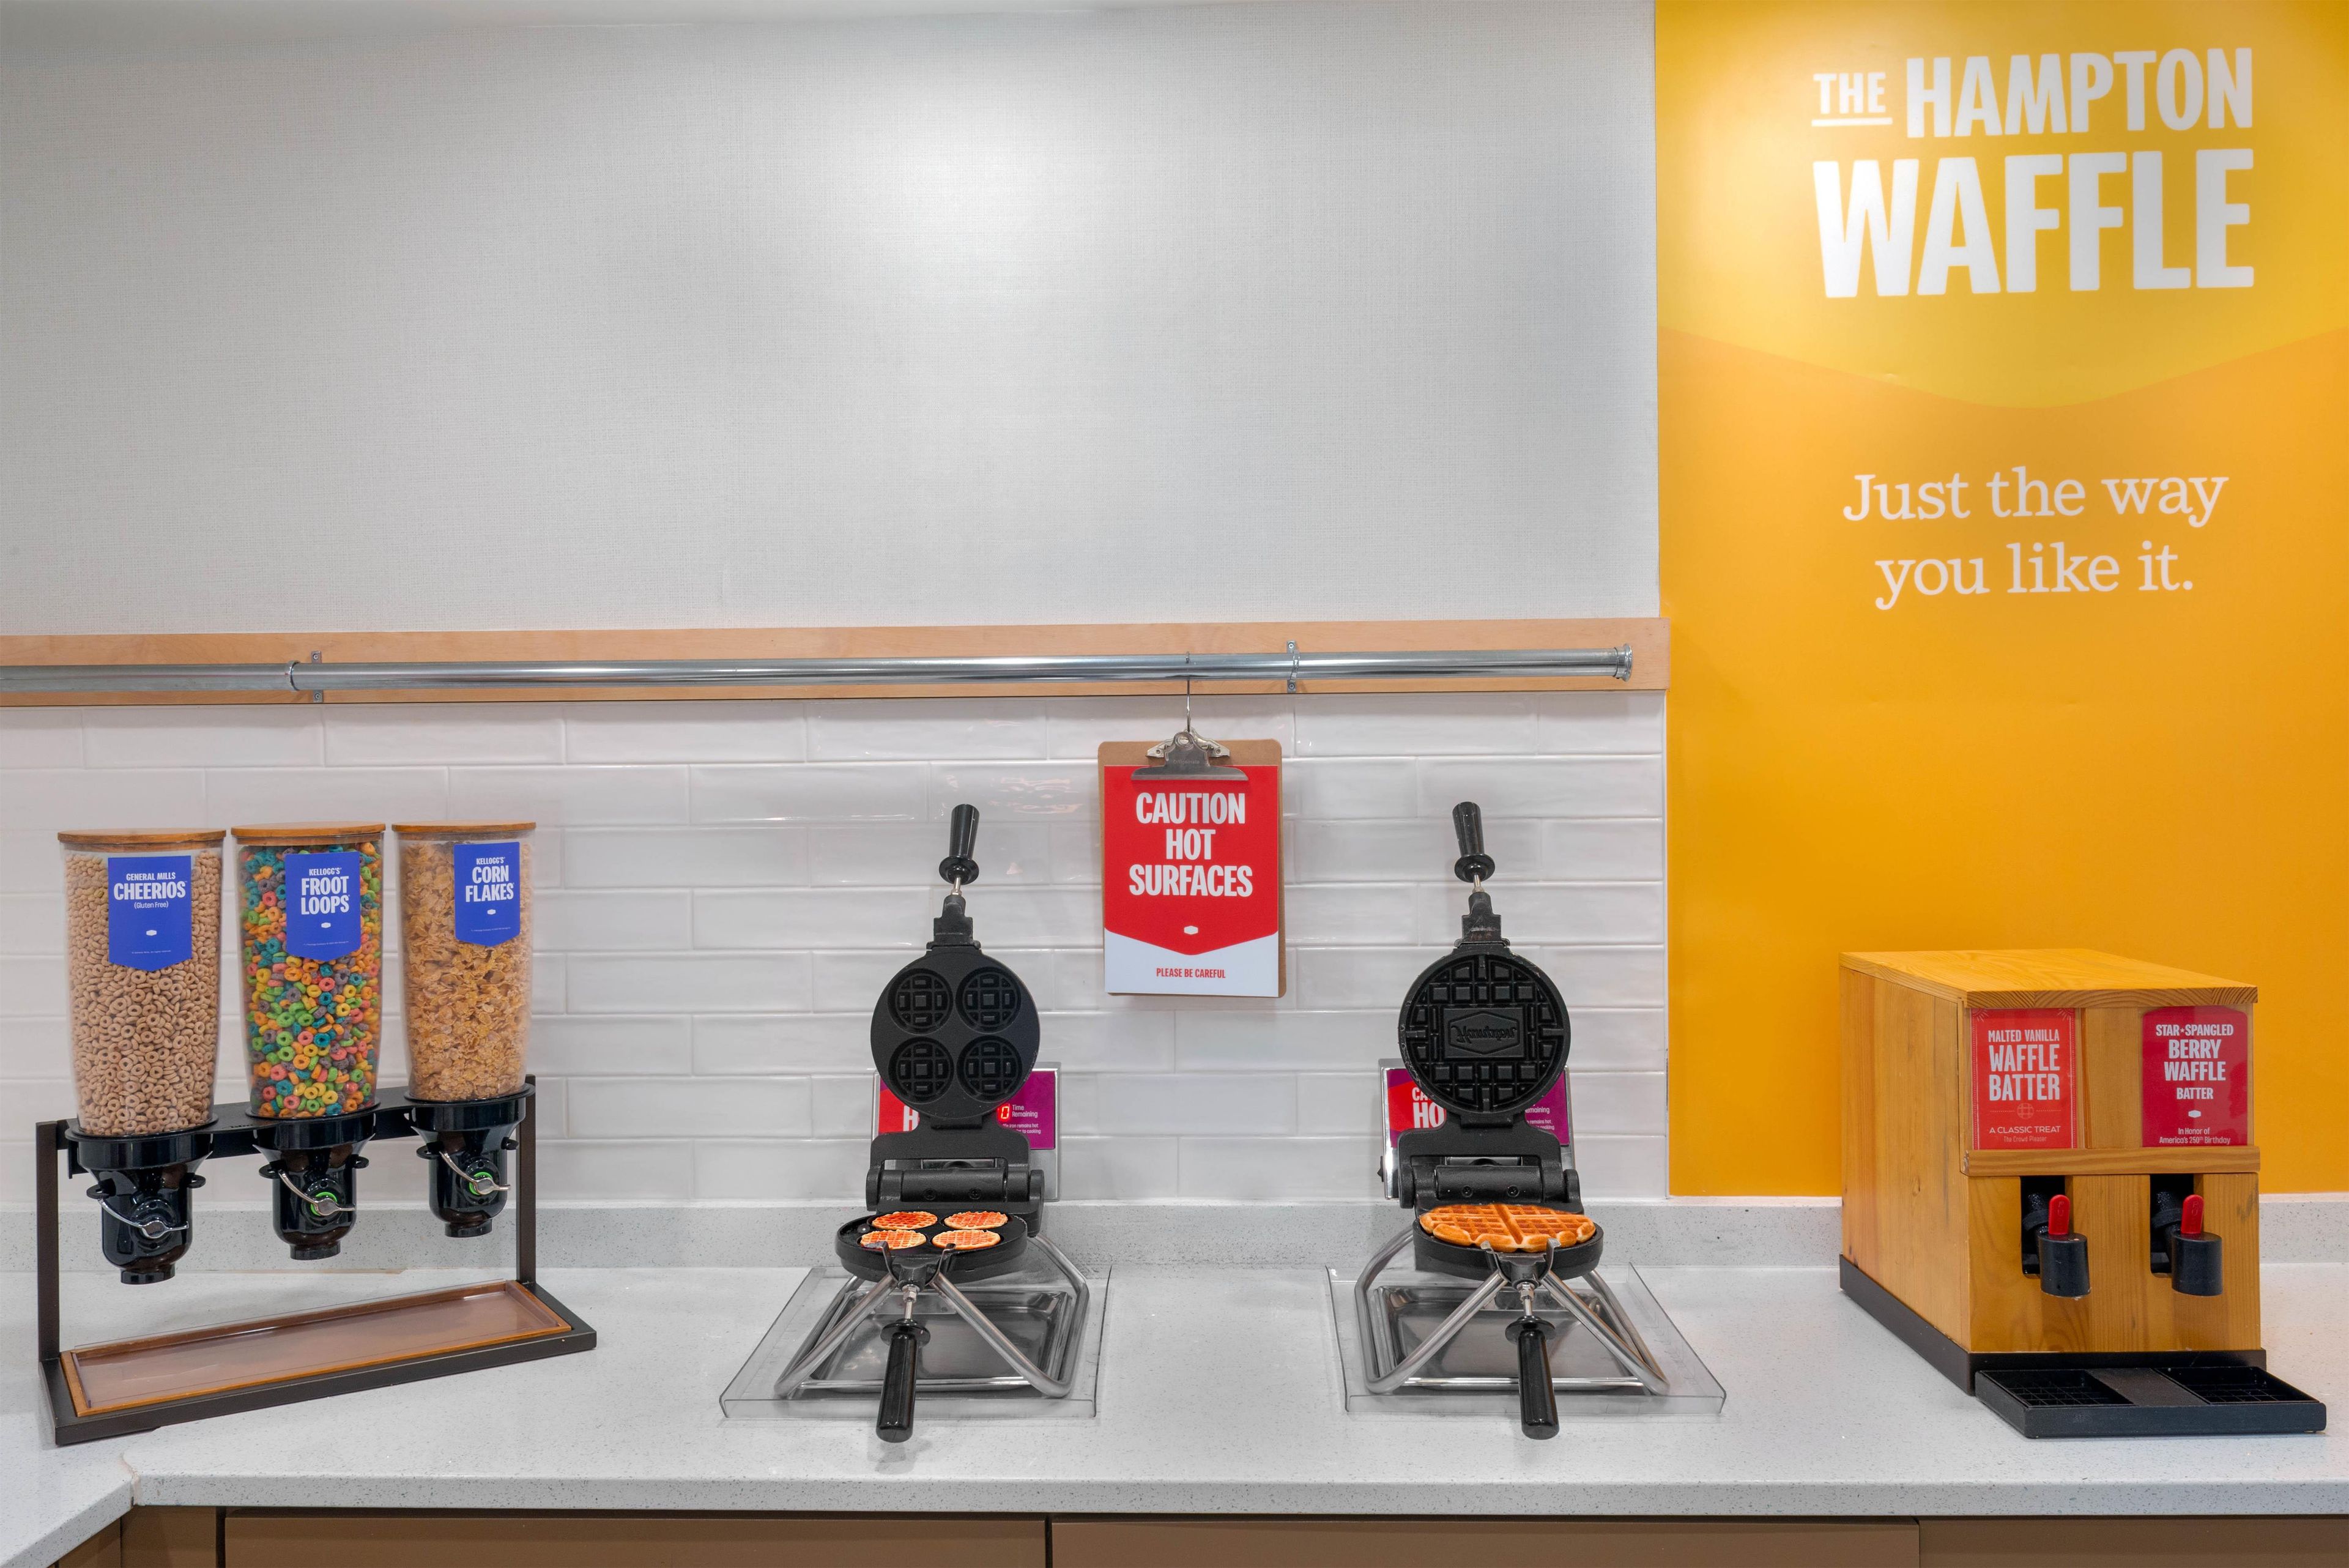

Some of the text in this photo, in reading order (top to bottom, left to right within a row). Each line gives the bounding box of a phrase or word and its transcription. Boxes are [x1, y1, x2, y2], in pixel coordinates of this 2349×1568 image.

[1814, 48, 2252, 139] THE HAMPTON
[1813, 149, 2254, 299] WAFFLE
[1843, 466, 2229, 527] Just the way
[1876, 541, 2192, 610] you like it.
[1136, 793, 1245, 824] CAUTION
[1166, 829, 1216, 860] HOT
[157, 872, 176, 880] MILLS
[309, 868, 341, 876] KELLOGG'S
[472, 865, 509, 883] CORN
[1129, 864, 1253, 897] SURFACES
[114, 881, 186, 901] CHEERIOS
[302, 876, 349, 896] FROOT
[466, 882, 514, 902] FLAKES
[301, 894, 349, 915] LOOPS
[1157, 968, 1225, 978] PLEASE BE CAREFUL
[1988, 1029, 2060, 1042] MALTED VANILLA
[1989, 1044, 2060, 1072] WAFFLE
[2169, 1039, 2221, 1059] BERRY
[2164, 1061, 2226, 1081] WAFFLE
[1989, 1074, 2060, 1101] BATTER
[2176, 1088, 2214, 1099] BATTER
[2205, 1136, 2231, 1145] Birthday
